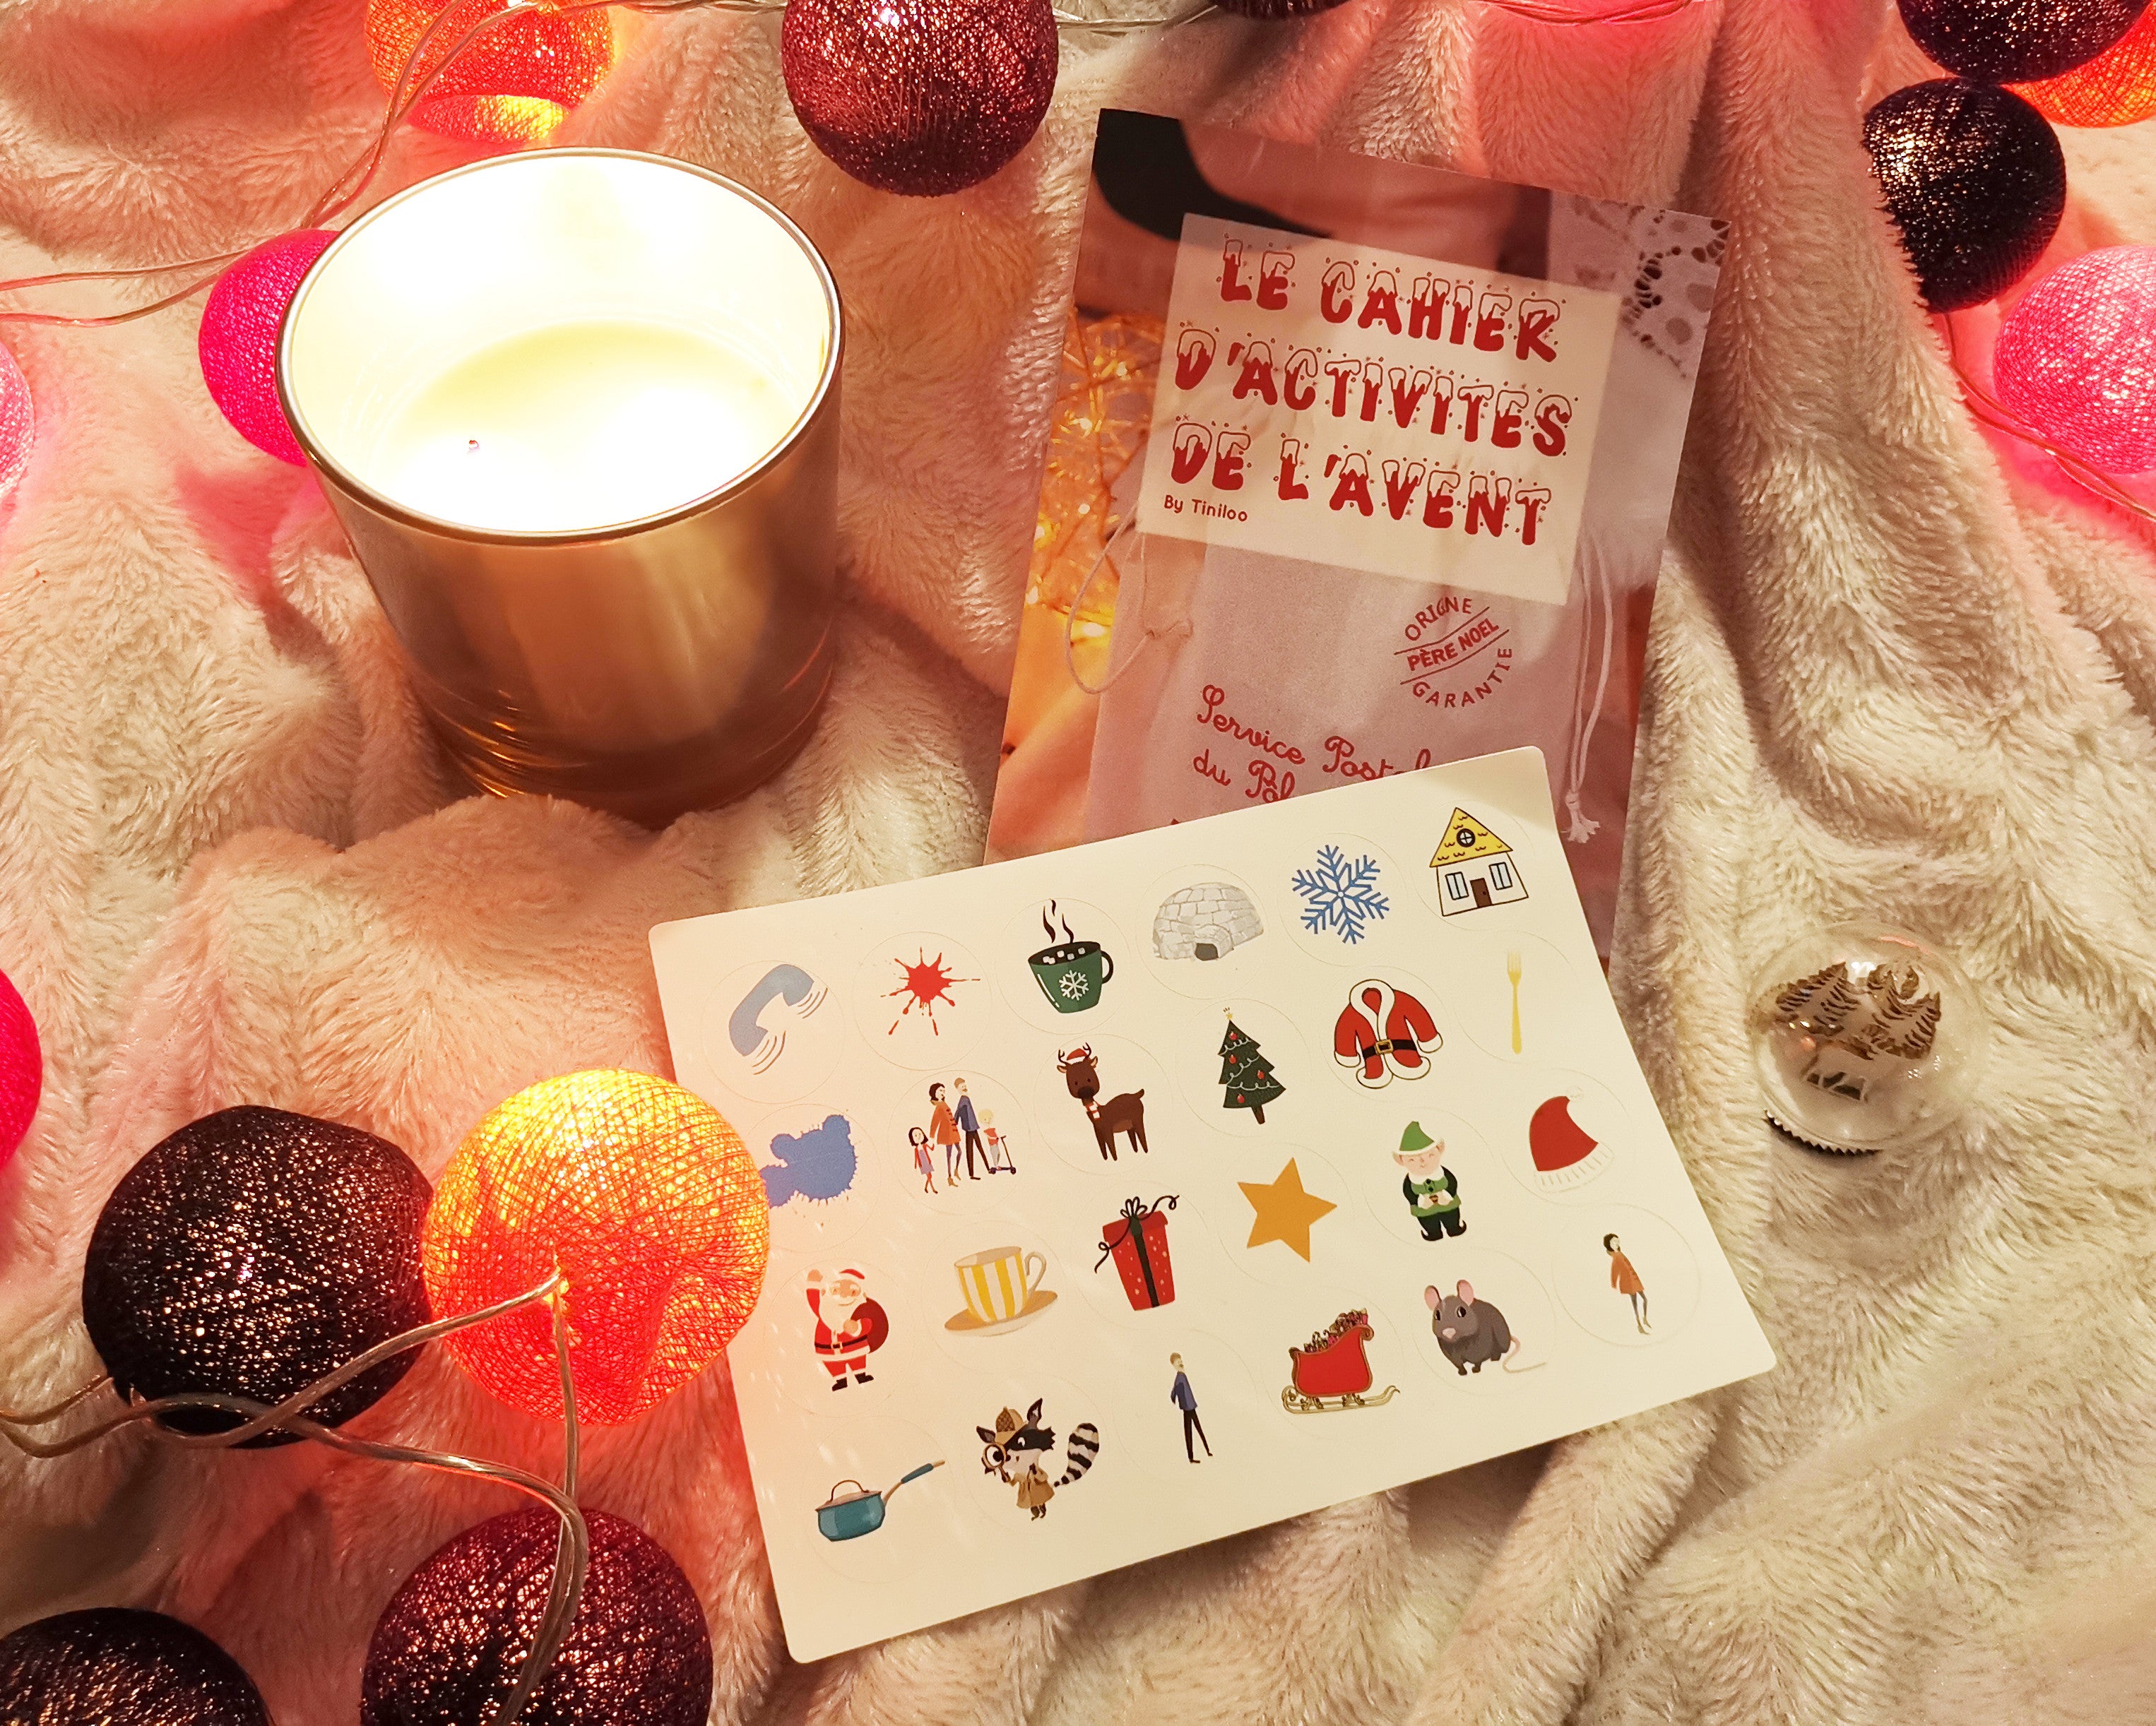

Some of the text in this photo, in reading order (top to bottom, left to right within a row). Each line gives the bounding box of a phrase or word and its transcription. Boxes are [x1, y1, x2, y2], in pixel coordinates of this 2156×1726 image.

[1221, 239, 1560, 363] LE CAHIER
[1175, 328, 1572, 457] D'ACTIVITES
[1163, 494, 1248, 522] By Tiniloo
[1171, 422, 1552, 546] DE L'AVENT
[1407, 618, 1500, 671] PÈRE NOEL
[1413, 648, 1512, 708] GARANTIE
[1197, 684, 1432, 781] Service Postl
[1193, 749, 1296, 803] du Pôl
